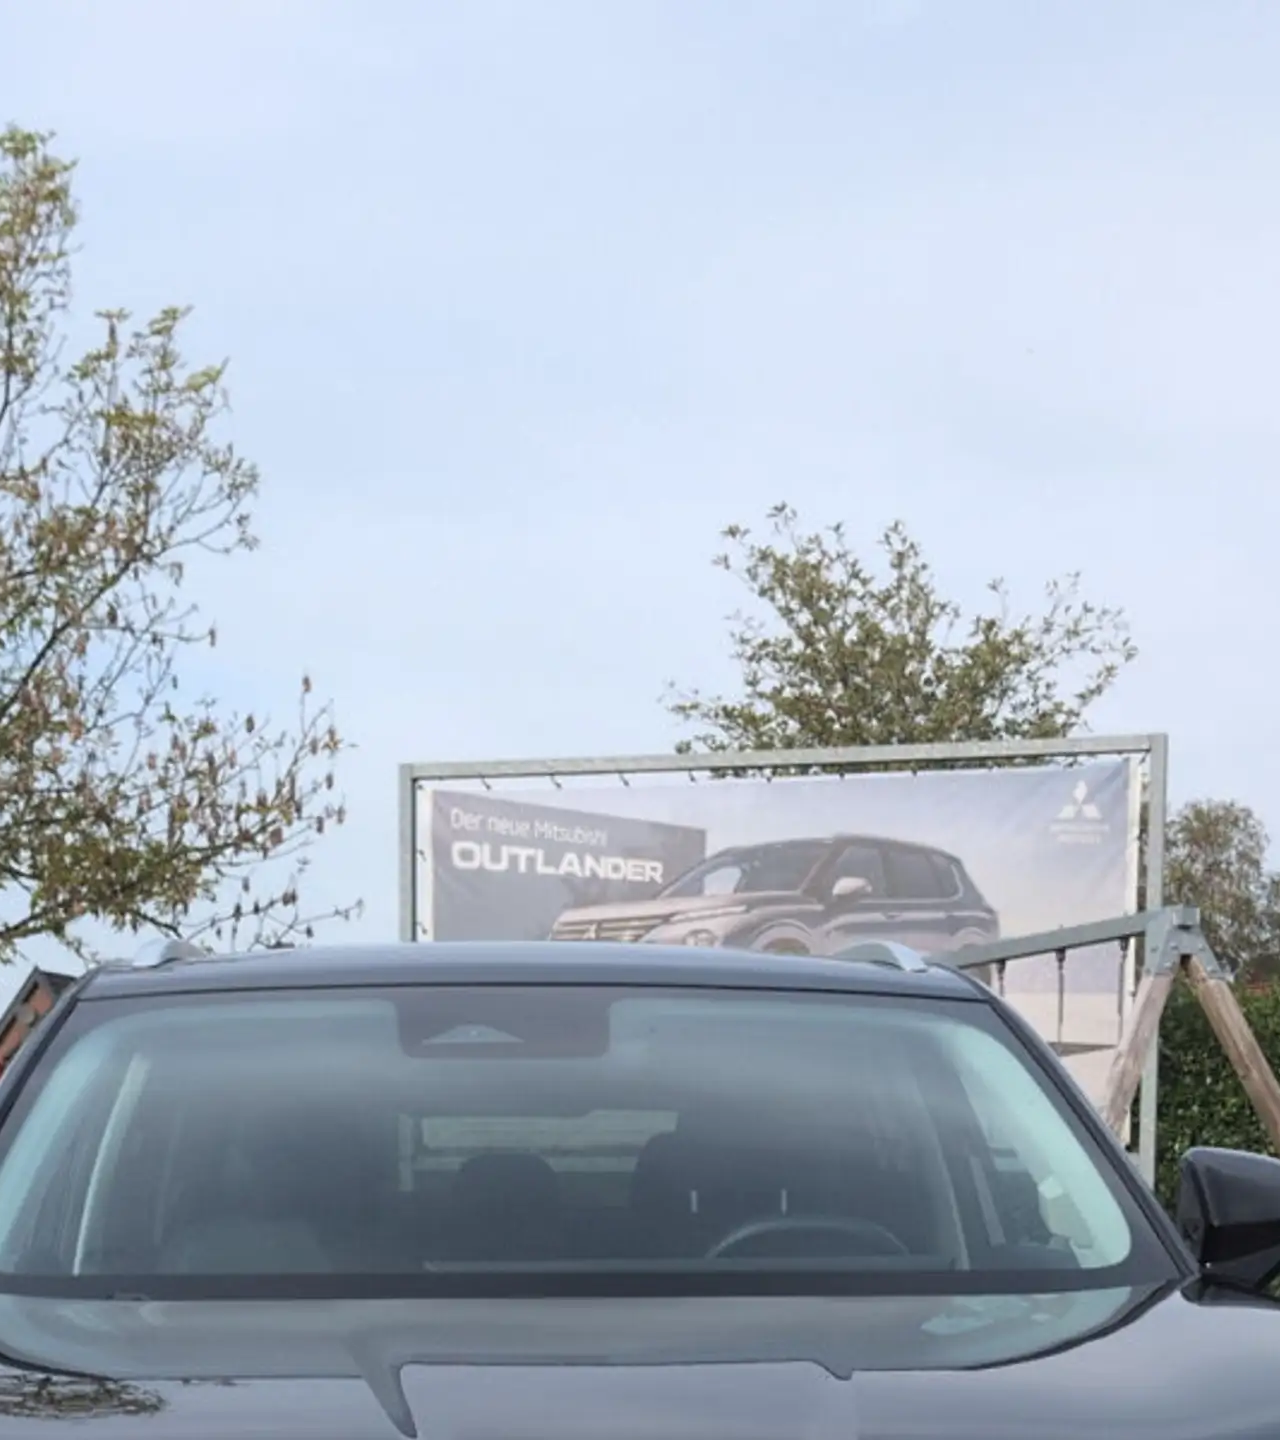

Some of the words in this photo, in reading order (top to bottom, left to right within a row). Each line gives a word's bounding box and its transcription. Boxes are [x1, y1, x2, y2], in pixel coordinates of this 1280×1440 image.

[450, 807, 482, 831] Der
[488, 815, 530, 839] neue
[451, 840, 664, 884] OUTLANDER
